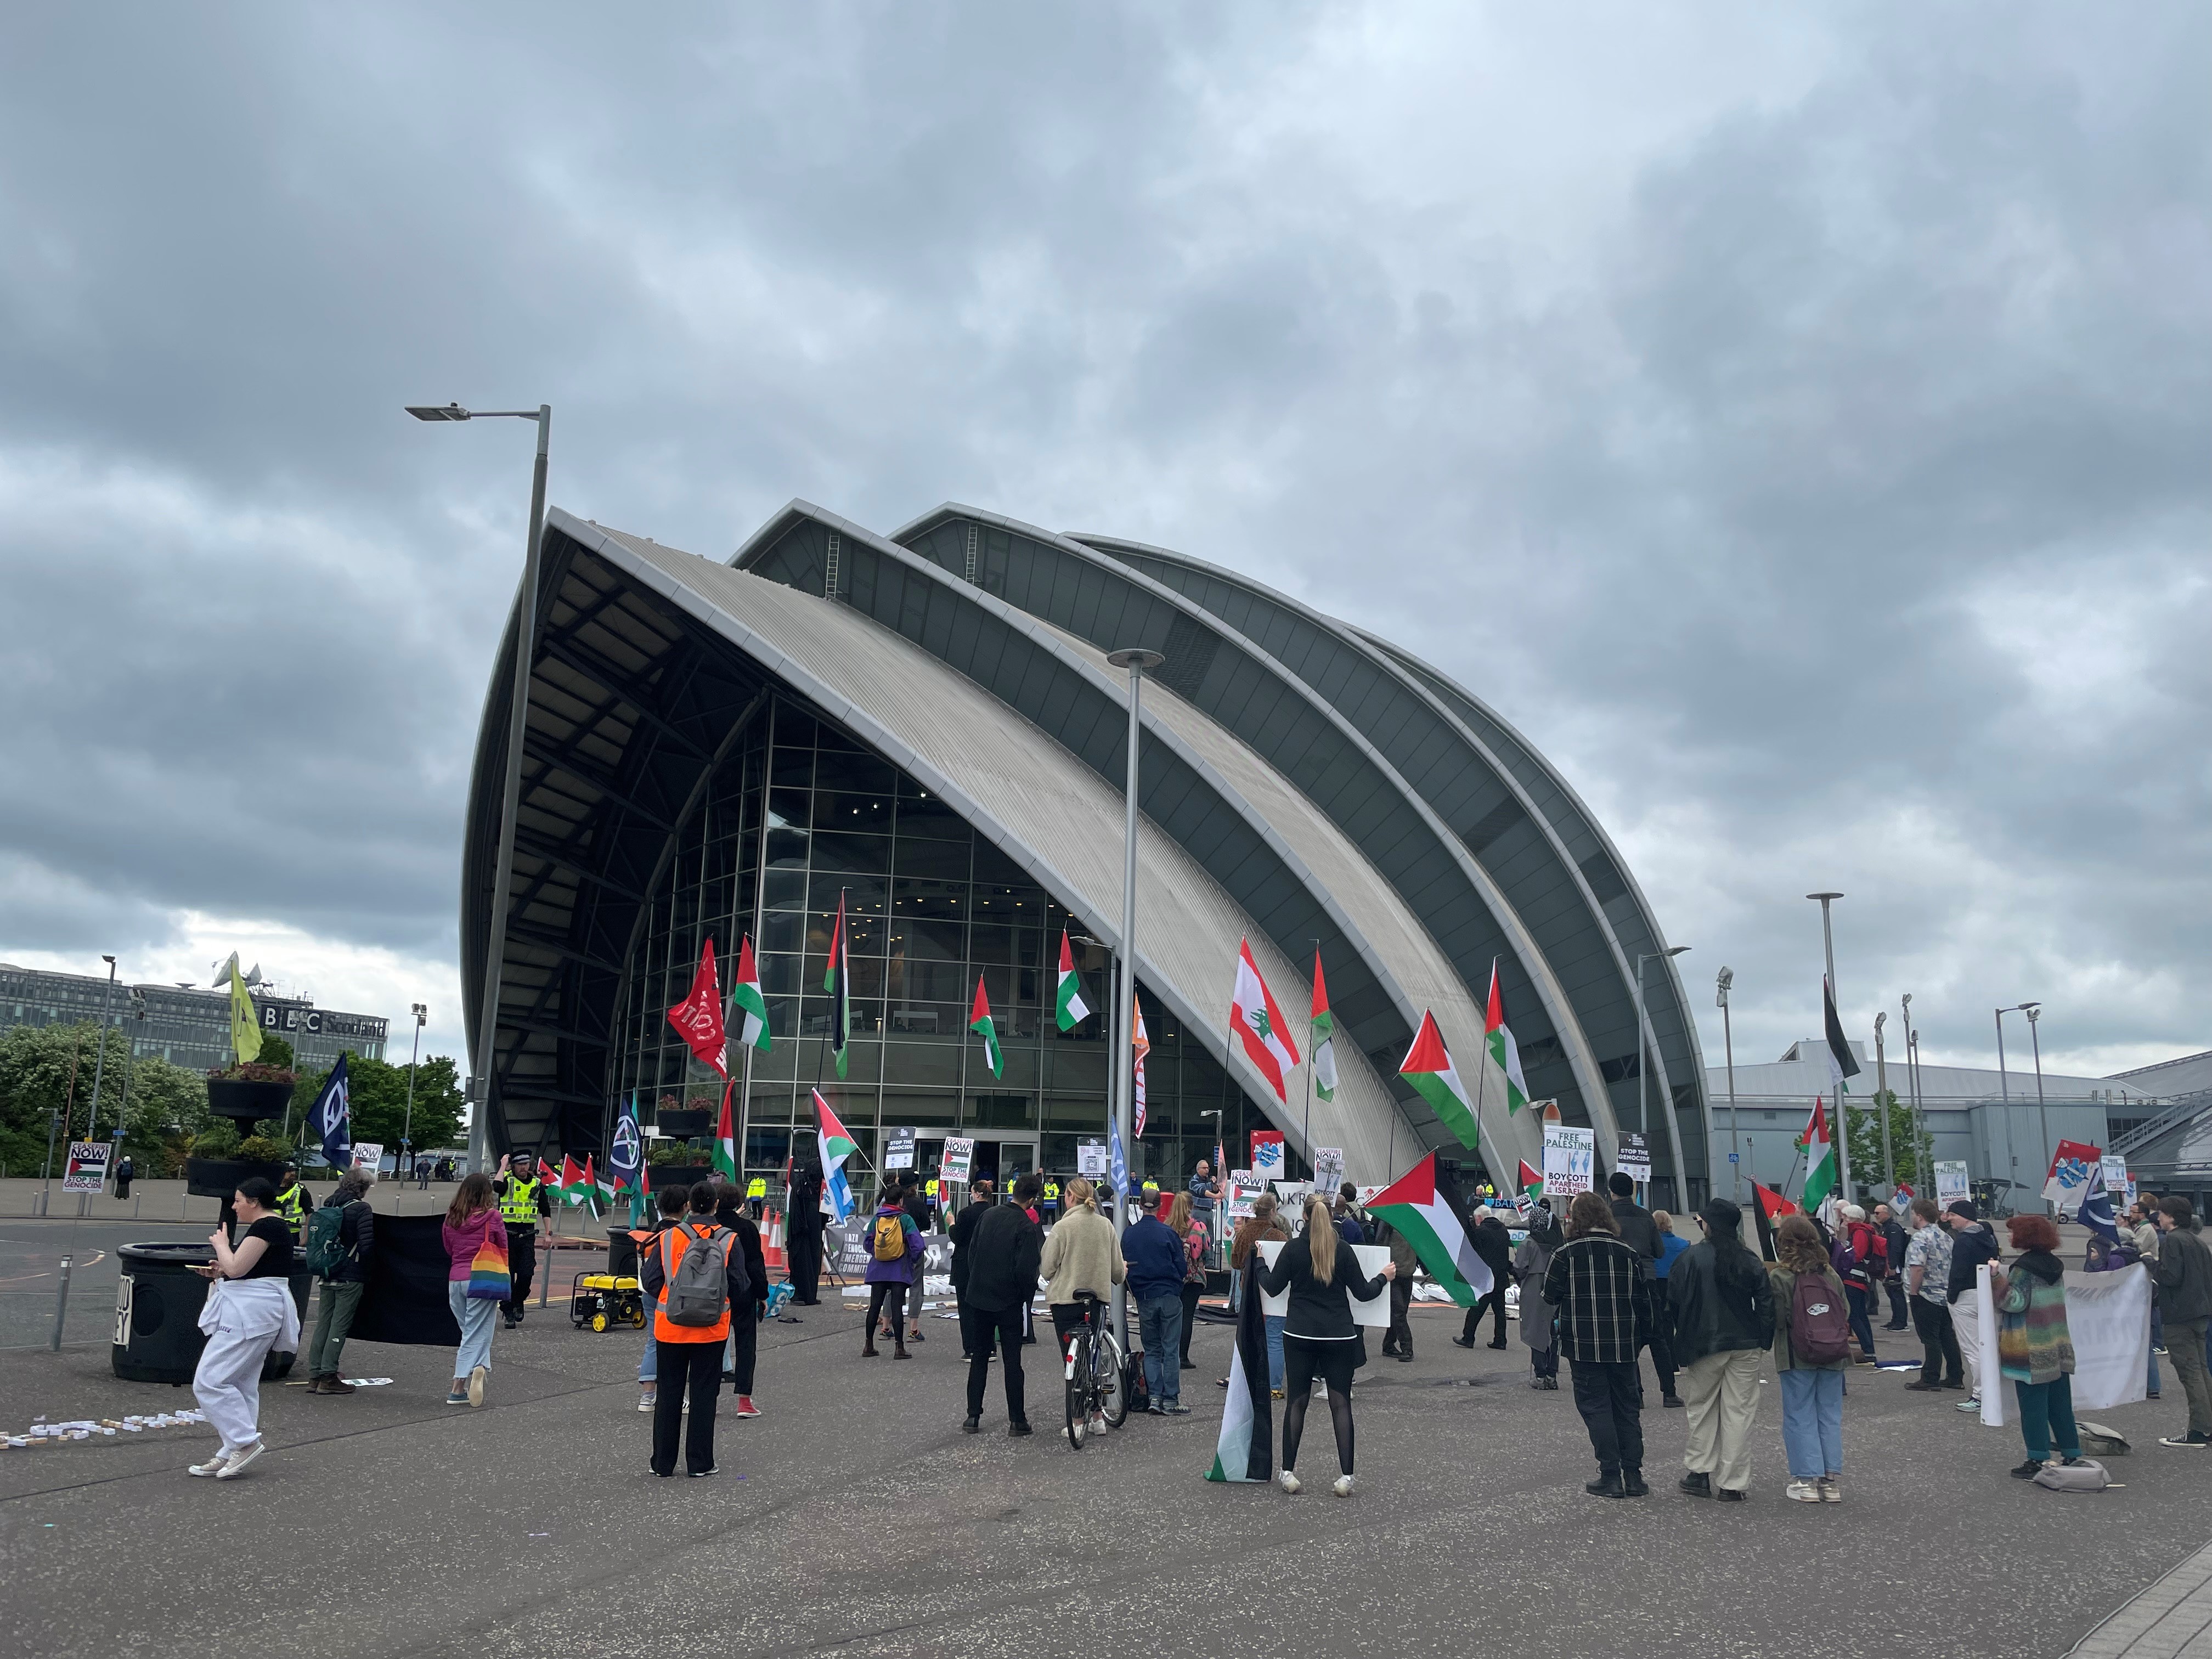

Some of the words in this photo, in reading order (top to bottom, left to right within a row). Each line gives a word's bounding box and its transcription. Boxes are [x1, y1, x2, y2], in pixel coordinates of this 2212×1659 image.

[327, 1015, 386, 1037] Scotland
[1559, 1133, 1579, 1142] FREE
[945, 1142, 972, 1153] NOW!
[1546, 1138, 1592, 1150] PALESTINE
[71, 1148, 109, 1159] NOW!
[354, 1148, 381, 1159] NOW!
[1618, 1154, 1650, 1162] GENOCIDE
[1549, 1172, 1589, 1182] BOYCOTT
[1549, 1180, 1588, 1189] APARTHEID
[843, 1243, 867, 1254] GENOCI
[840, 1253, 871, 1263] EMERGEN
[838, 1263, 867, 1274] COMMITT
